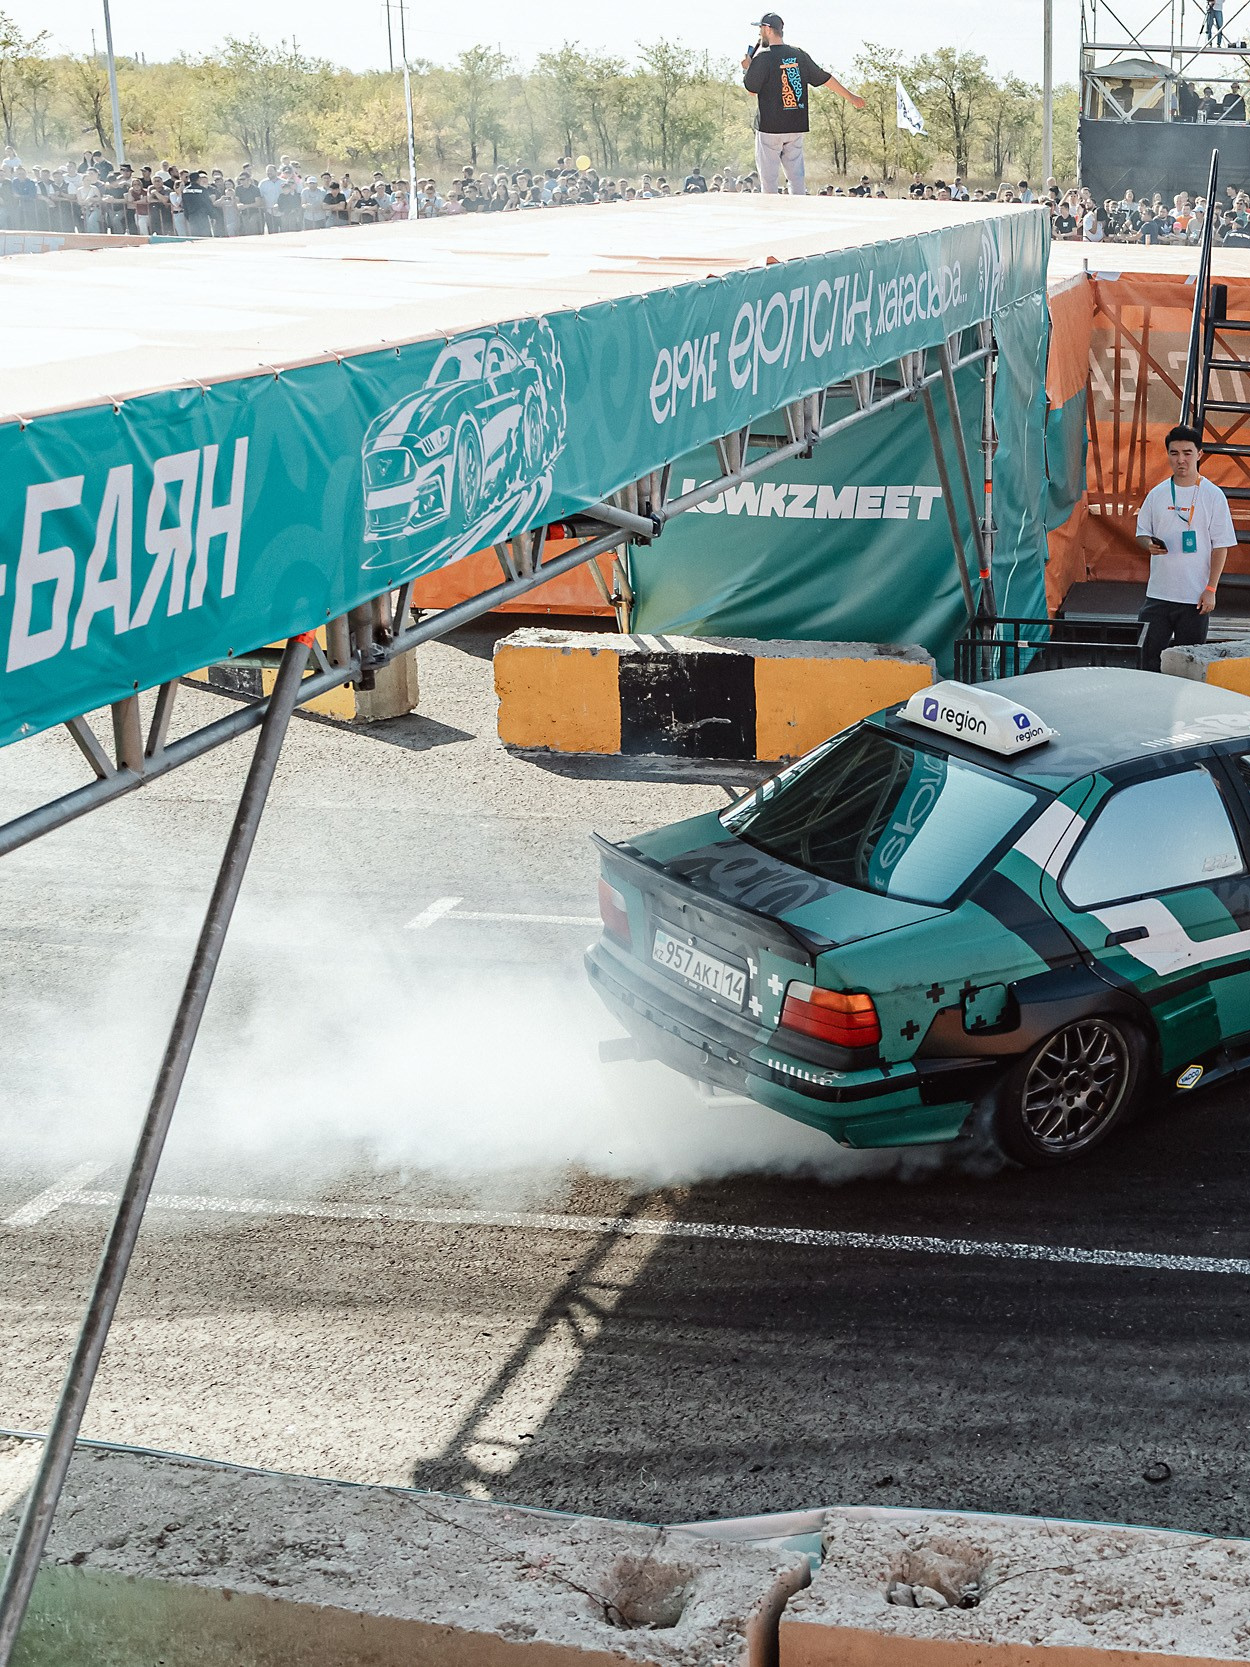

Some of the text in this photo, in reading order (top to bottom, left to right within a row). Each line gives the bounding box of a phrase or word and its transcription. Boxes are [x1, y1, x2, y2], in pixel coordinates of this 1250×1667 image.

[0, 436, 249, 673] БАЯН
[940, 707, 987, 735] region
[1016, 727, 1044, 743] region
[654, 947, 664, 961] KZ
[666, 941, 694, 973] 957
[725, 972, 743, 1002] 14
